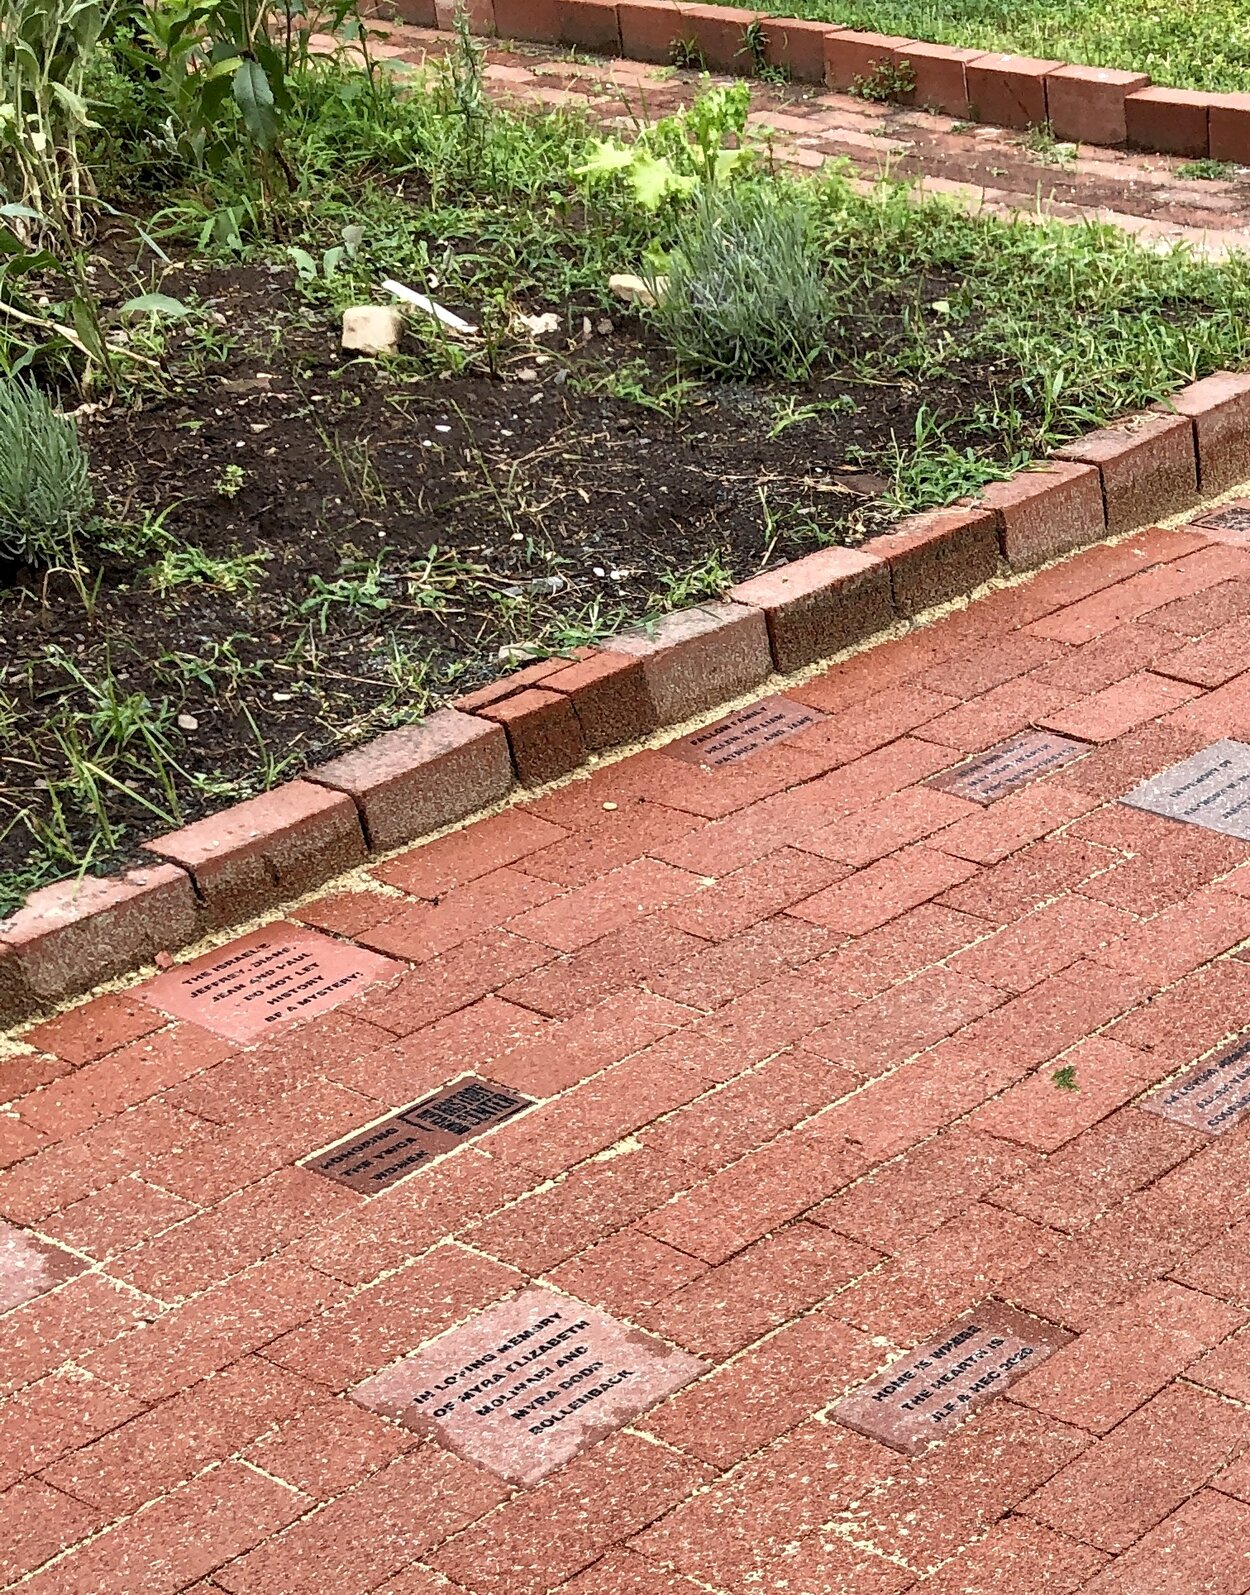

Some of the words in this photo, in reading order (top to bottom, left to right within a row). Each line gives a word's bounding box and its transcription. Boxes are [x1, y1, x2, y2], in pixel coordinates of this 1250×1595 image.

[690, 724, 730, 745] FALLON
[730, 705, 767, 725] FAMILY
[743, 713, 784, 735] WILLIAM
[763, 729, 785, 741] AND
[1180, 767, 1220, 791] MEMORY
[1217, 759, 1234, 767] OF
[182, 970, 211, 985] THE
[188, 966, 251, 997] JEFFREY,
[210, 983, 245, 1002] JEAN
[247, 969, 276, 984] AND
[276, 951, 311, 969] PAUL
[243, 989, 263, 1001] DO
[266, 975, 294, 990] NOT
[294, 961, 320, 975] LET
[267, 975, 325, 1004] HISTORY
[264, 1011, 283, 1022] BE
[297, 971, 363, 1005] MYSTERY!
[1177, 1067, 1217, 1095] LOVING
[430, 1083, 496, 1116] HISTORY
[455, 1093, 518, 1125] CENTER
[319, 1127, 398, 1169] HONORING
[341, 1159, 372, 1177] THE
[374, 1136, 416, 1159] YWCA
[372, 1149, 428, 1181] WOMEN
[413, 1390, 433, 1404] IN
[434, 1352, 496, 1390] LOVING
[495, 1312, 563, 1353] MEMORY
[432, 1401, 456, 1417] OF
[457, 1372, 504, 1402] MYRA
[504, 1320, 590, 1372] ELIZABETH
[554, 1345, 588, 1367] AND
[872, 1370, 916, 1401] HOME
[915, 1359, 931, 1371] IS
[929, 1323, 981, 1360] WHERE
[902, 1389, 932, 1411] THE
[931, 1348, 988, 1389] HEARTH
[986, 1337, 1003, 1349] IS
[512, 1388, 560, 1419] MYRA
